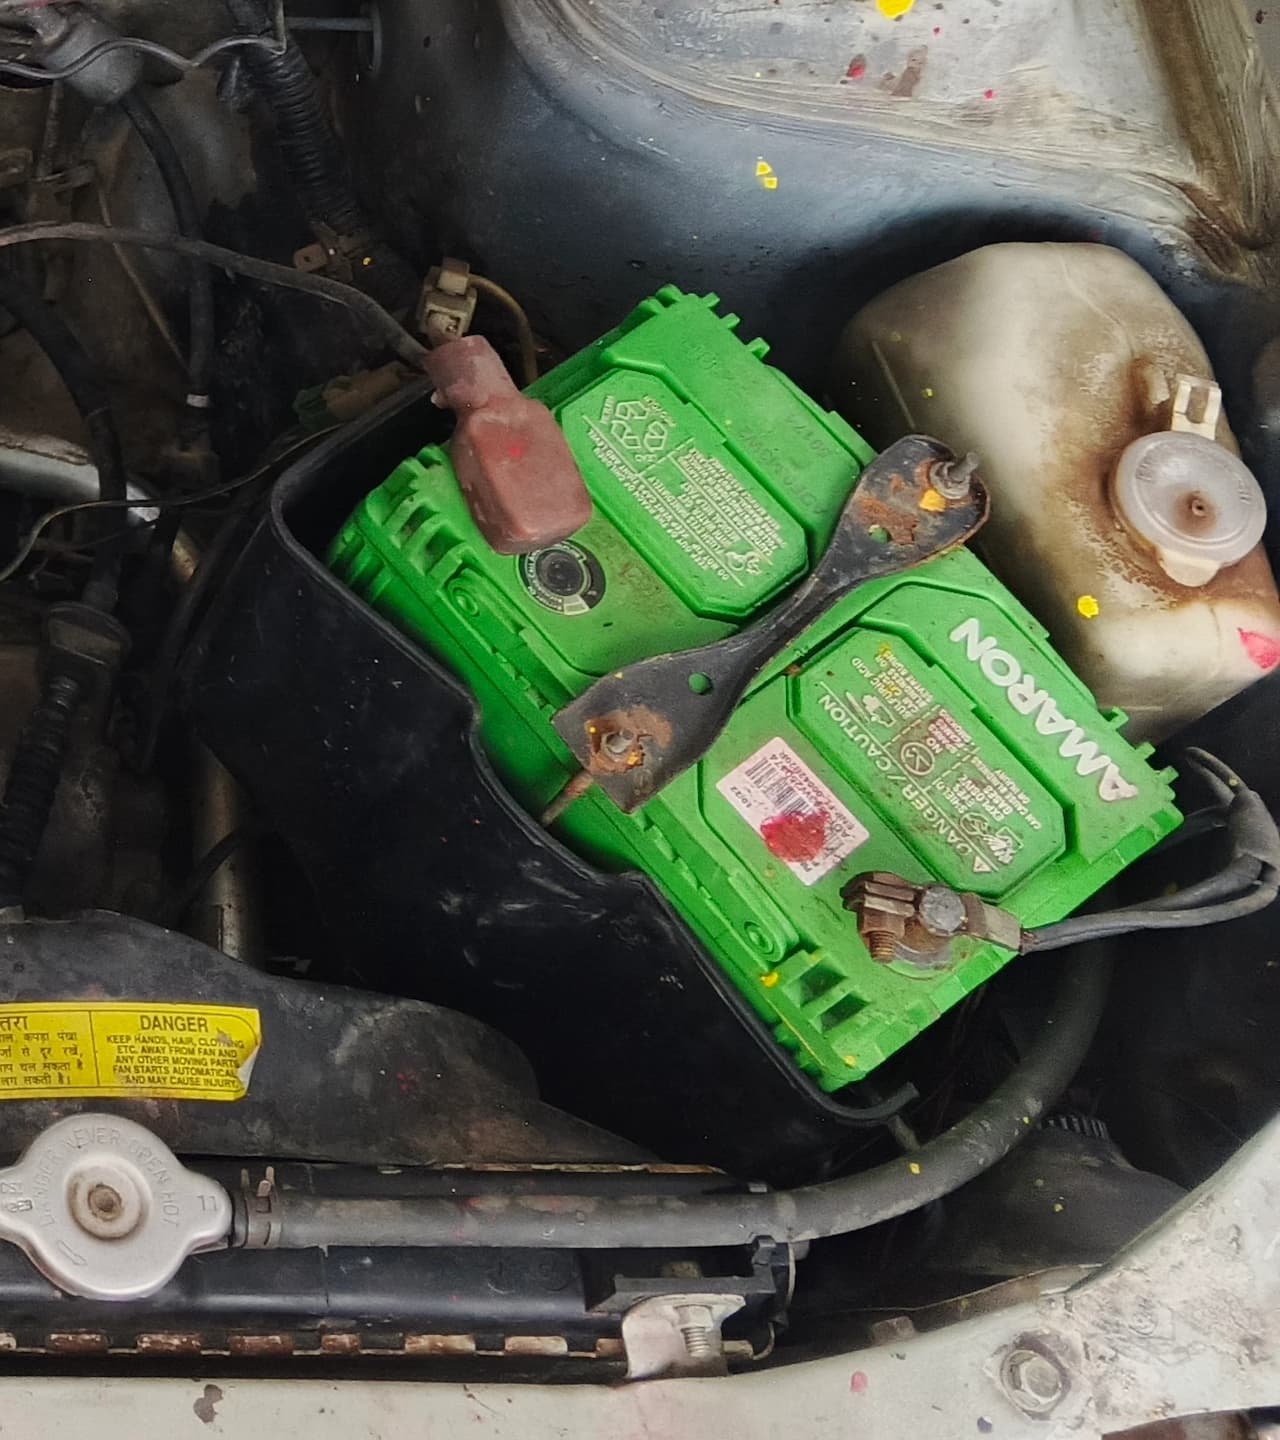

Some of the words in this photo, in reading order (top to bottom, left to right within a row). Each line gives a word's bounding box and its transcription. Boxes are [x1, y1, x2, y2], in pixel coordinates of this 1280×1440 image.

[850, 656, 872, 677] ACID
[869, 676, 911, 719] SULFURIC
[902, 697, 918, 712] CAN
[950, 618, 1138, 802] AMARON
[817, 693, 893, 772] CAUTION
[927, 723, 956, 753] SPARKS
[925, 736, 942, 753] NO
[935, 781, 968, 813] SHIELD
[952, 783, 976, 806] EYES
[958, 773, 1004, 821] EXPLOSIVE
[982, 784, 1012, 814] GASES
[1004, 792, 1027, 815] CAUSE
[900, 783, 972, 857] DANGER
[1025, 814, 1041, 829] CAN
[140, 1015, 208, 1033] DANGER
[107, 1035, 131, 1044] KEEP
[134, 1035, 170, 1045] HANDS,
[171, 1037, 196, 1046] HAIR,
[117, 1045, 138, 1054] ETC.
[141, 1046, 166, 1054] AWAY
[169, 1047, 195, 1055] FROM
[198, 1048, 216, 1056] FAN
[218, 1049, 237, 1057] AND
[21, 1047, 30, 1056] से
[40, 1048, 51, 1058] दूर
[137, 1056, 169, 1064] OTHER
[172, 1057, 208, 1065] MOVING
[113, 1065, 131, 1073] FAN
[134, 1066, 170, 1074] STARTS
[1, 1077, 16, 1085] लग
[126, 1076, 144, 1084] AND
[147, 1076, 167, 1084] MAY
[170, 1077, 200, 1085] CAUSE
[63, 1127, 121, 1150] NEVER
[128, 1139, 172, 1185] OPEN
[162, 1191, 180, 1228] HOT
